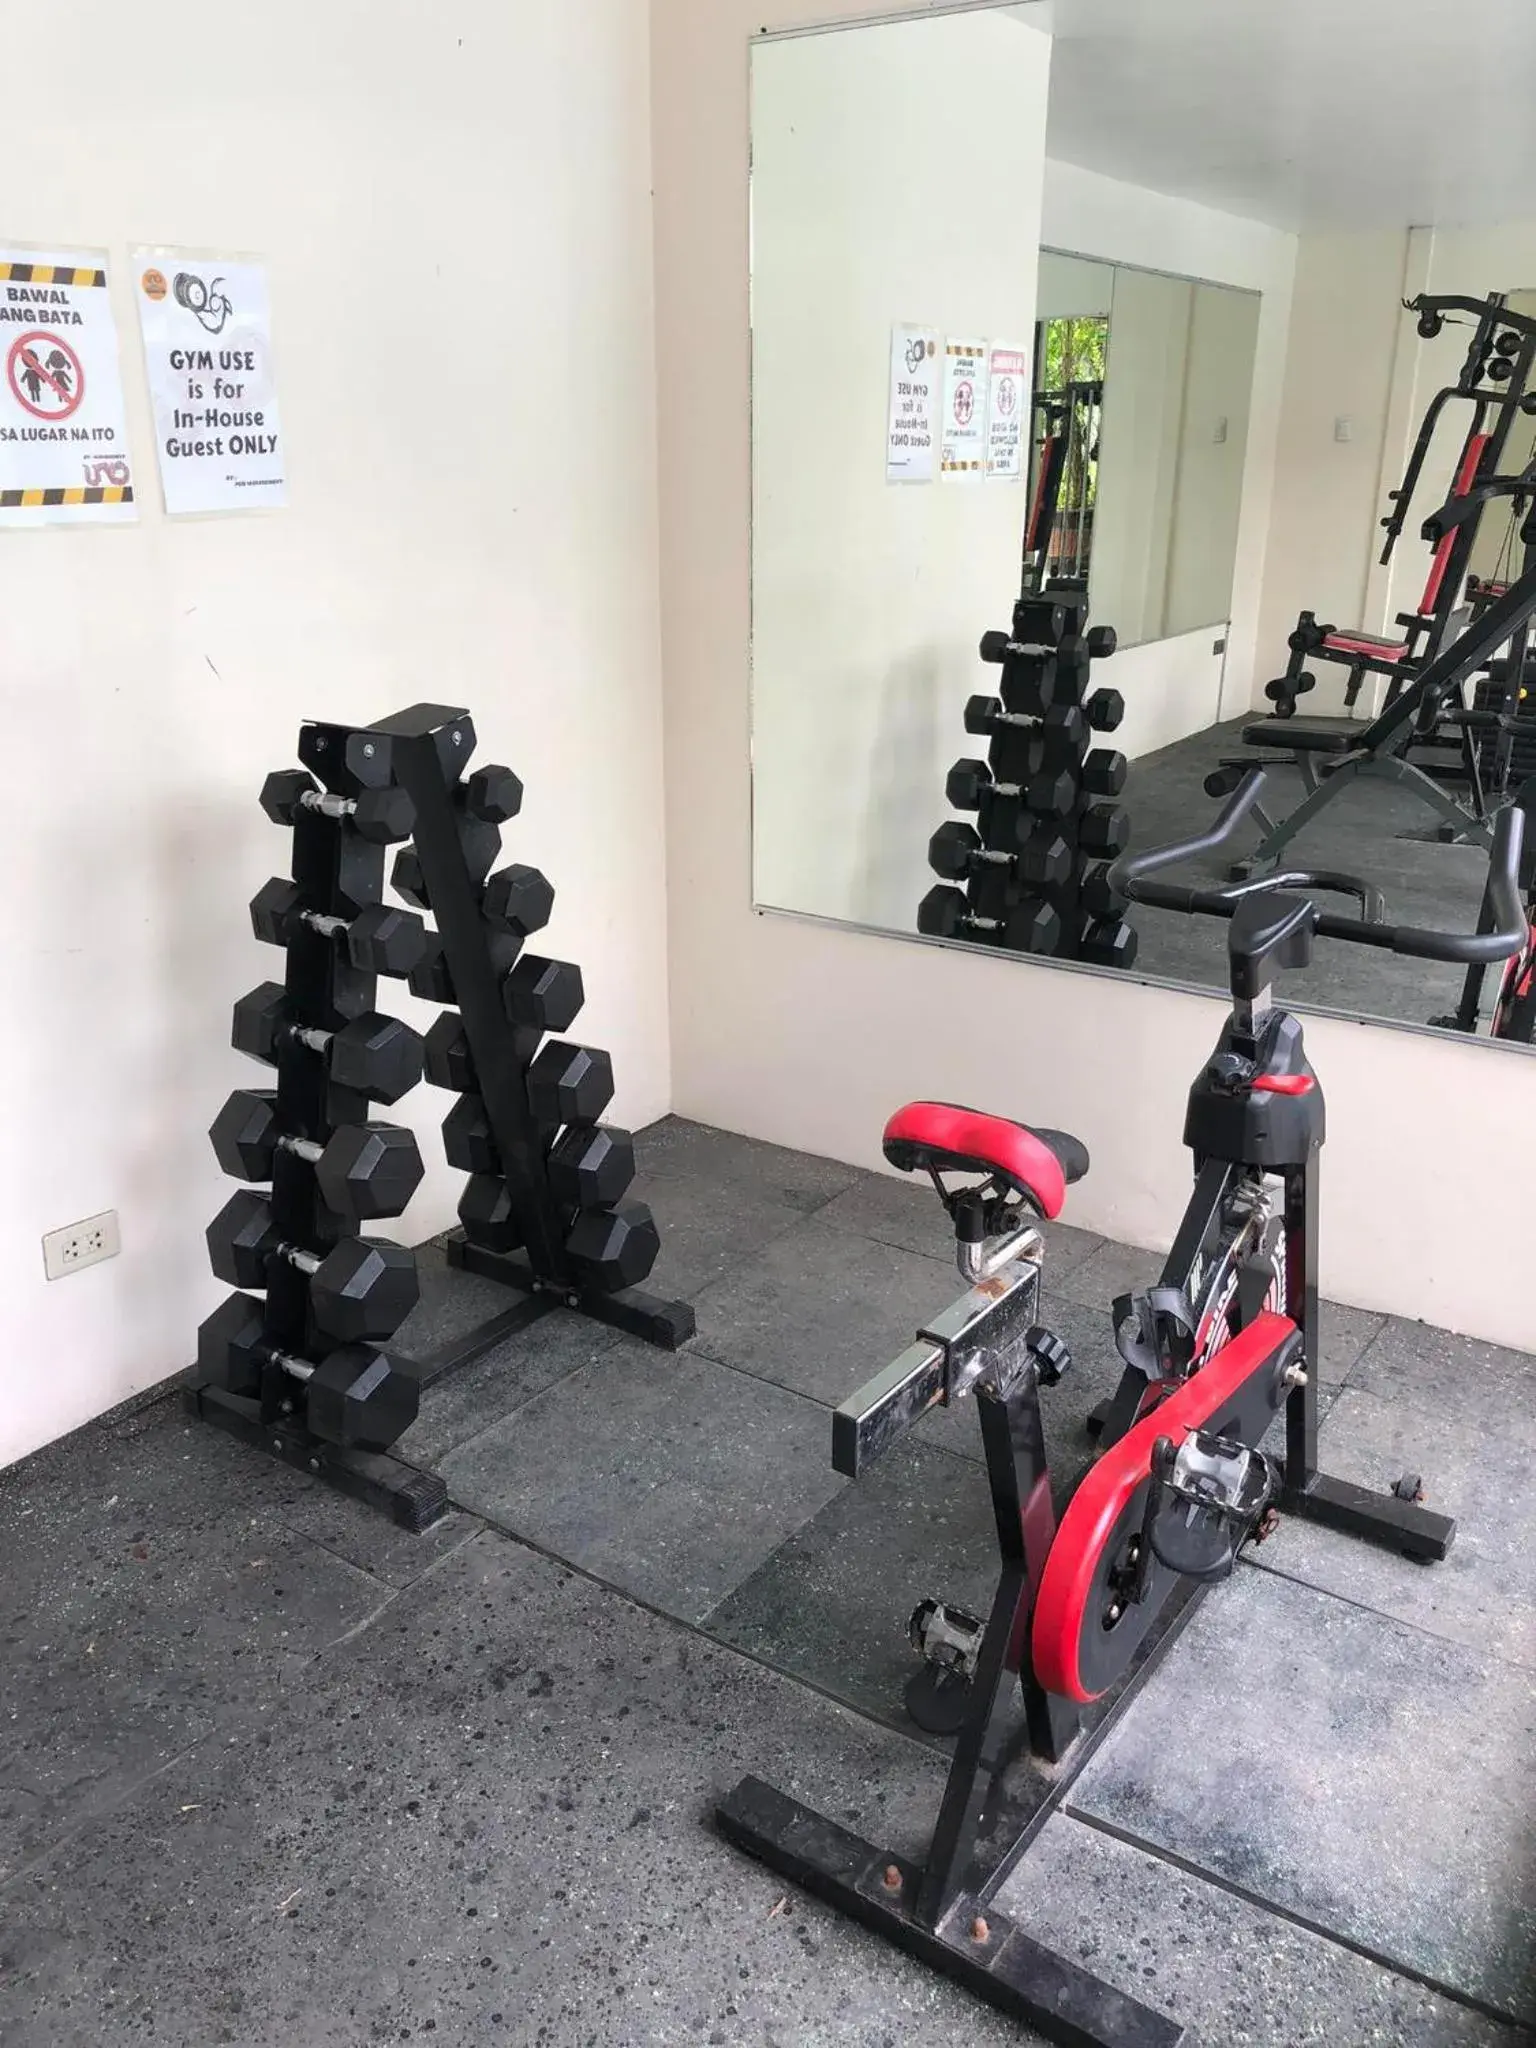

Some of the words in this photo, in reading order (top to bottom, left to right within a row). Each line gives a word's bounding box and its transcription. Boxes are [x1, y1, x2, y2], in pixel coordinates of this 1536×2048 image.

[6, 287, 71, 305] BAWAL
[0, 307, 36, 323] ANG
[39, 310, 84, 325] BATA
[170, 350, 214, 371] GYM
[219, 351, 255, 371] USE
[188, 379, 203, 399] is
[213, 377, 244, 399] for
[174, 408, 264, 429] In-House
[0, 428, 18, 441] SA
[21, 428, 67, 441] LUGAR
[71, 428, 89, 441] NA
[92, 427, 115, 440] ITO
[166, 437, 224, 457] Guest
[229, 435, 278, 455] ONLY
